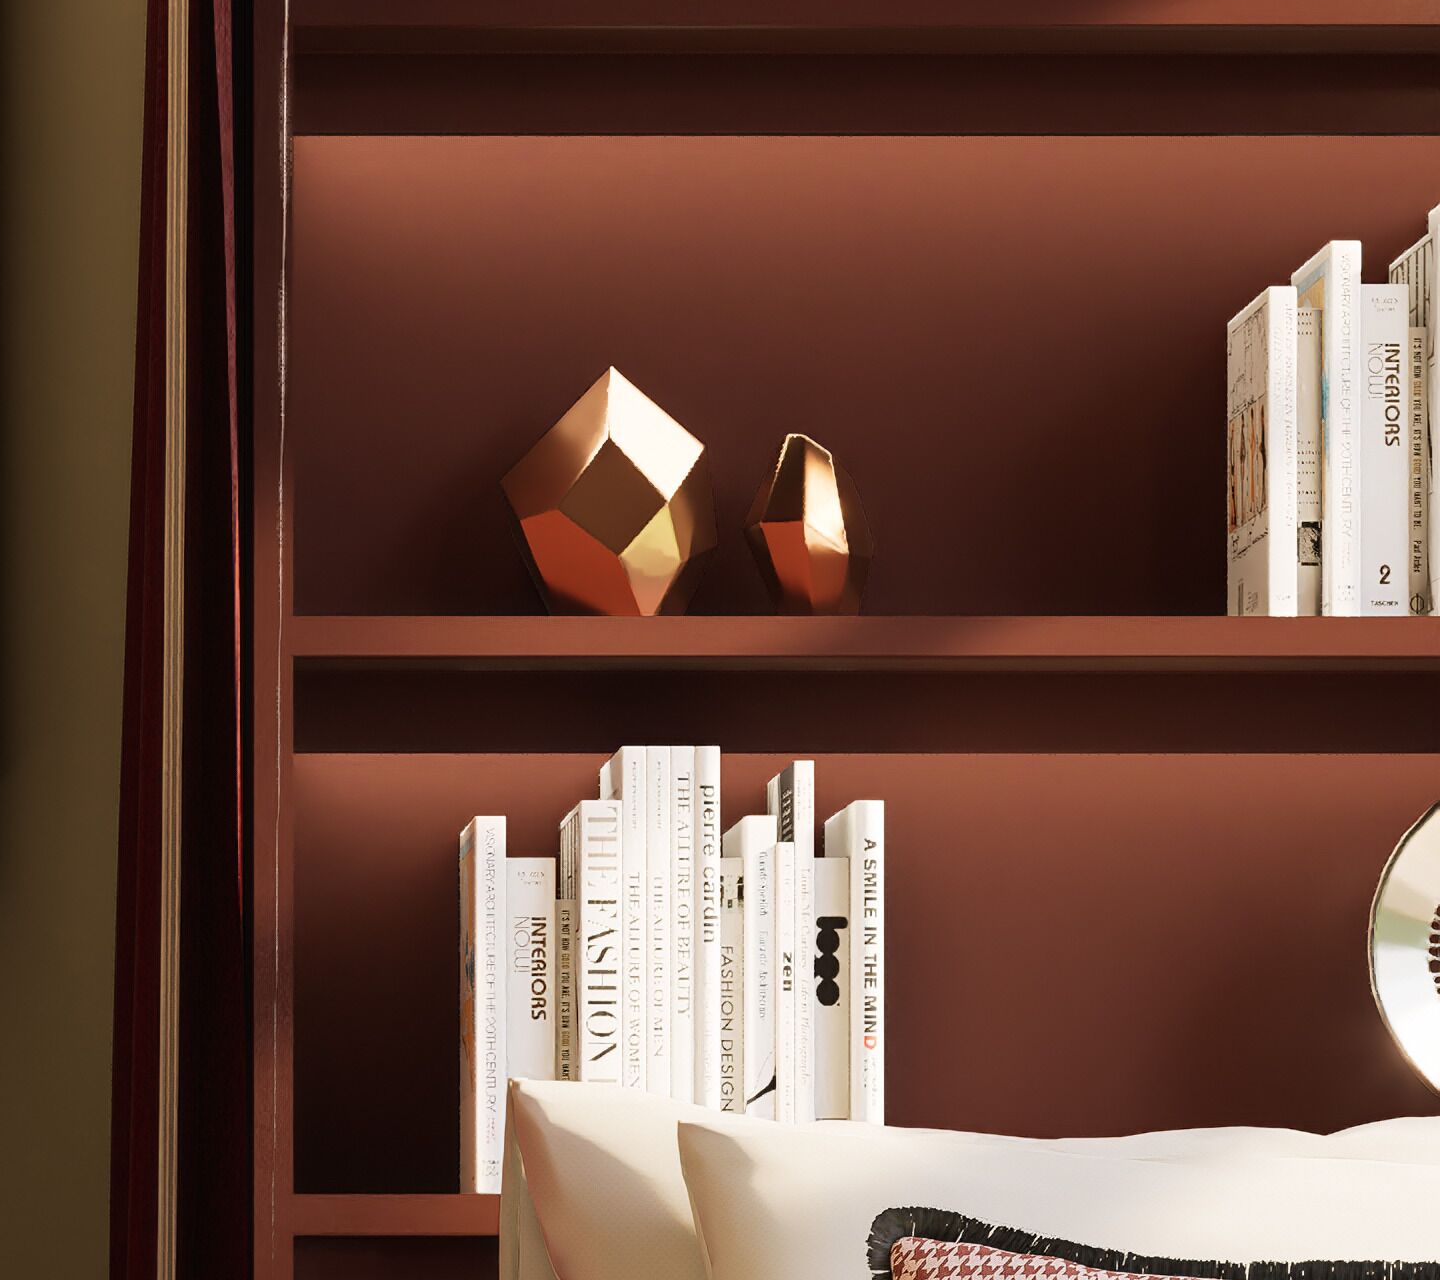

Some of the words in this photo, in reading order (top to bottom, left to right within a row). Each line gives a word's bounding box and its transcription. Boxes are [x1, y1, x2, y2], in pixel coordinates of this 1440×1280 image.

[1385, 343, 1401, 447] INTERIORS
[1378, 564, 1392, 585] 2
[677, 771, 690, 814] THE
[700, 784, 719, 857] pierre
[587, 806, 618, 886] THE
[677, 818, 690, 899] ALLURE
[863, 837, 878, 852] A
[629, 871, 640, 911] THE
[677, 903, 690, 930] OF
[703, 866, 719, 944] cardin
[863, 858, 878, 918] SMILE
[514, 916, 531, 973] NOW!
[532, 916, 547, 1021] INTERIORS
[629, 913, 640, 985] ALLURE
[863, 926, 878, 946] IN
[586, 898, 619, 1062] FASHION
[629, 989, 640, 1013] OF
[677, 935, 690, 1019] BEAUTY
[721, 945, 734, 1031] FASHION
[782, 951, 793, 992] zen
[863, 953, 878, 989] THE
[629, 1018, 640, 1088] WOMEN
[863, 995, 878, 1050] MIND
[721, 1039, 734, 1113] DESIGN
